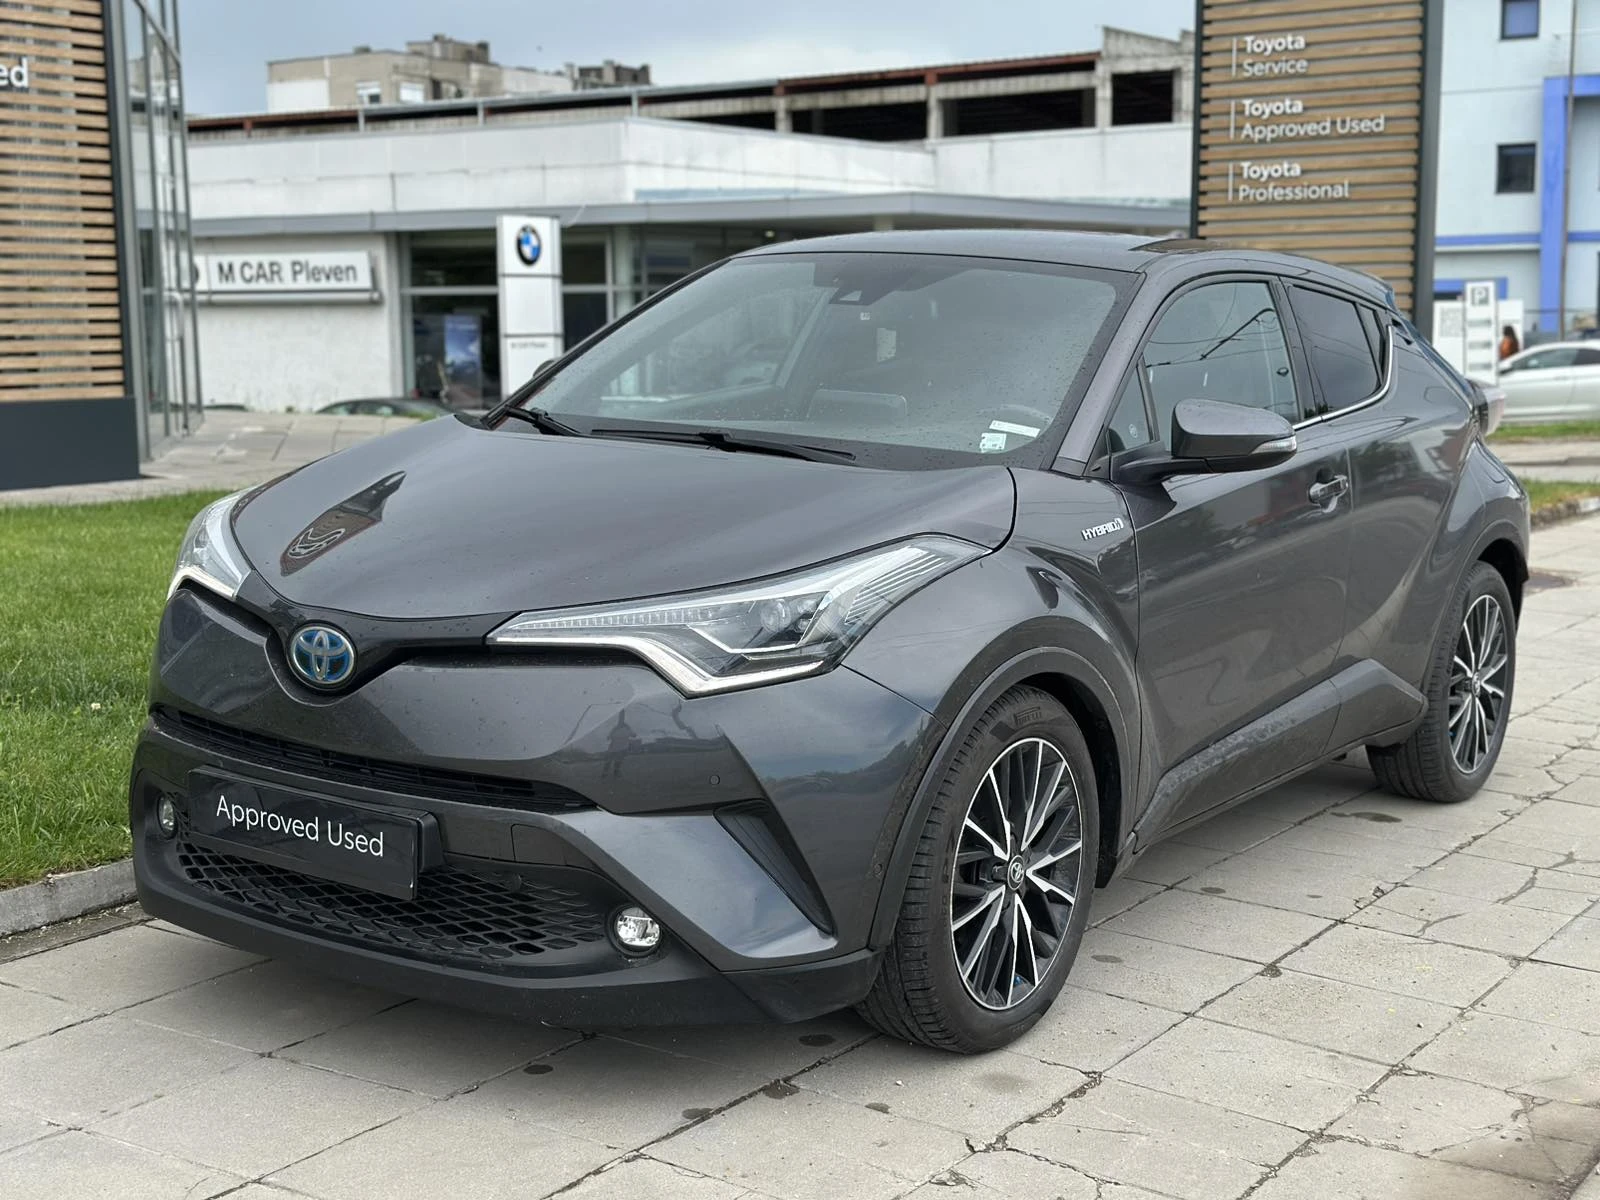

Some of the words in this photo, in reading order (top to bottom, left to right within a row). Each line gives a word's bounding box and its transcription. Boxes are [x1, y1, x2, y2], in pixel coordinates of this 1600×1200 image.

[1243, 35, 1306, 56] Toyota
[1242, 58, 1309, 76] Service
[1241, 98, 1304, 119] Toyota
[1240, 117, 1331, 142] Approved
[1335, 114, 1386, 134] Used
[1239, 160, 1302, 181] Toyota
[1238, 181, 1349, 201] Professional
[217, 262, 235, 284] M
[239, 261, 284, 284] CAR
[291, 260, 358, 283] Pleven
[1081, 520, 1119, 540] HYBRID
[216, 795, 320, 842] Approved
[327, 820, 384, 857] Used
